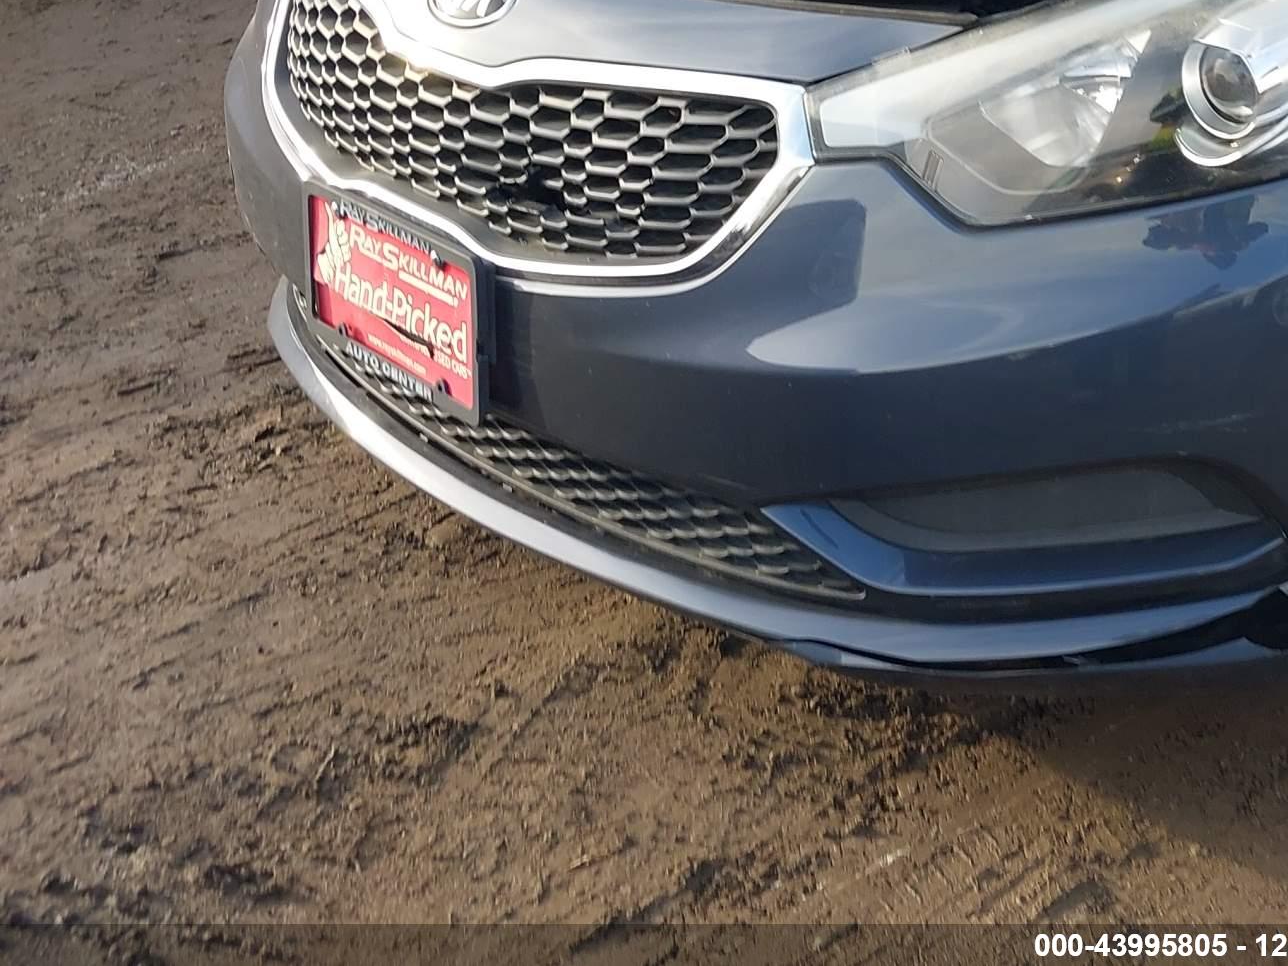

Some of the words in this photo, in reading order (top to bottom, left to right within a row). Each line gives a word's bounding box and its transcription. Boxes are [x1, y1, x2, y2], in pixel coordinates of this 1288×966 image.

[350, 223, 382, 256] RAY
[382, 241, 469, 301] SKILLMAN
[366, 214, 430, 255] SKILLMAN
[334, 263, 468, 363] Hand-Picked
[345, 341, 380, 368] AUTO
[381, 361, 433, 401] CENTER
